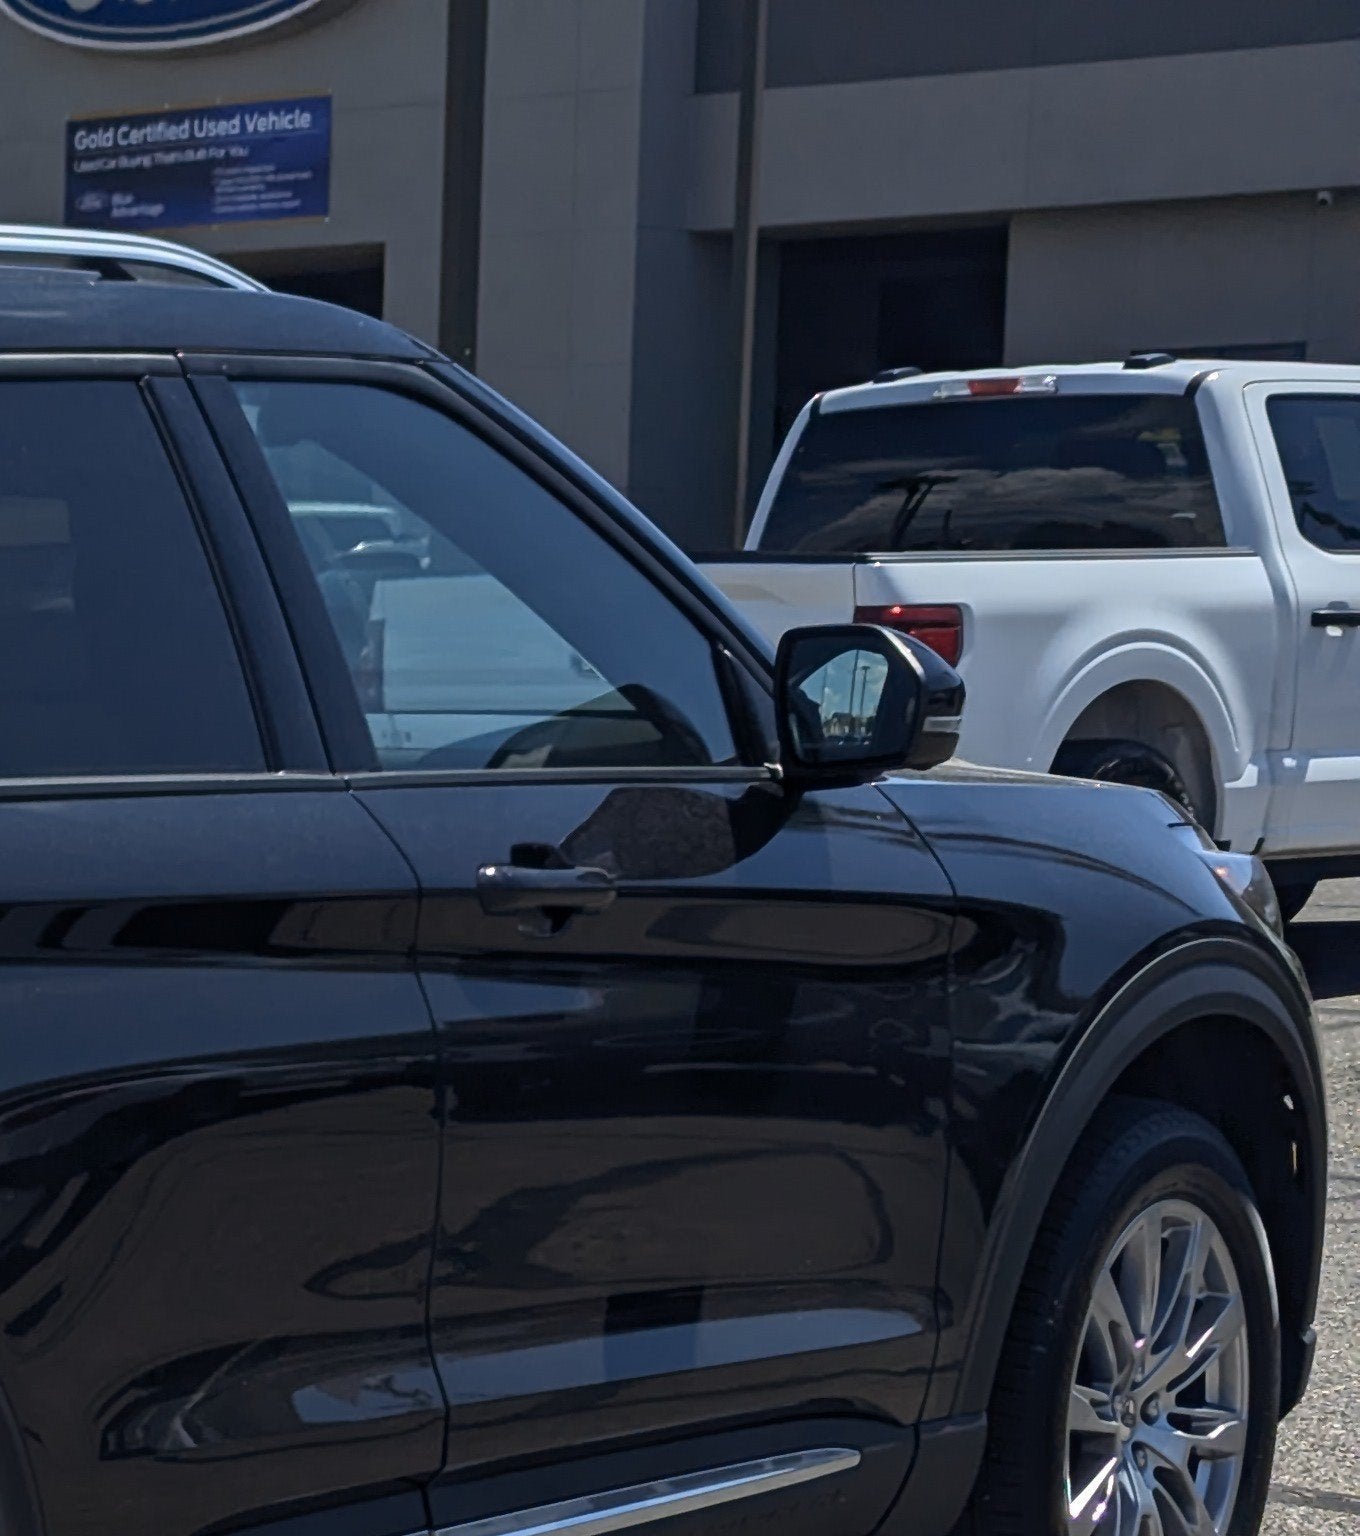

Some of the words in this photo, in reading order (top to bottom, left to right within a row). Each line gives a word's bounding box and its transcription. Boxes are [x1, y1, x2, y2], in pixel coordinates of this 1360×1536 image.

[73, 127, 114, 150] Gold
[116, 119, 189, 146] Certified
[193, 114, 240, 138] Used
[244, 108, 312, 133] Vehicle
